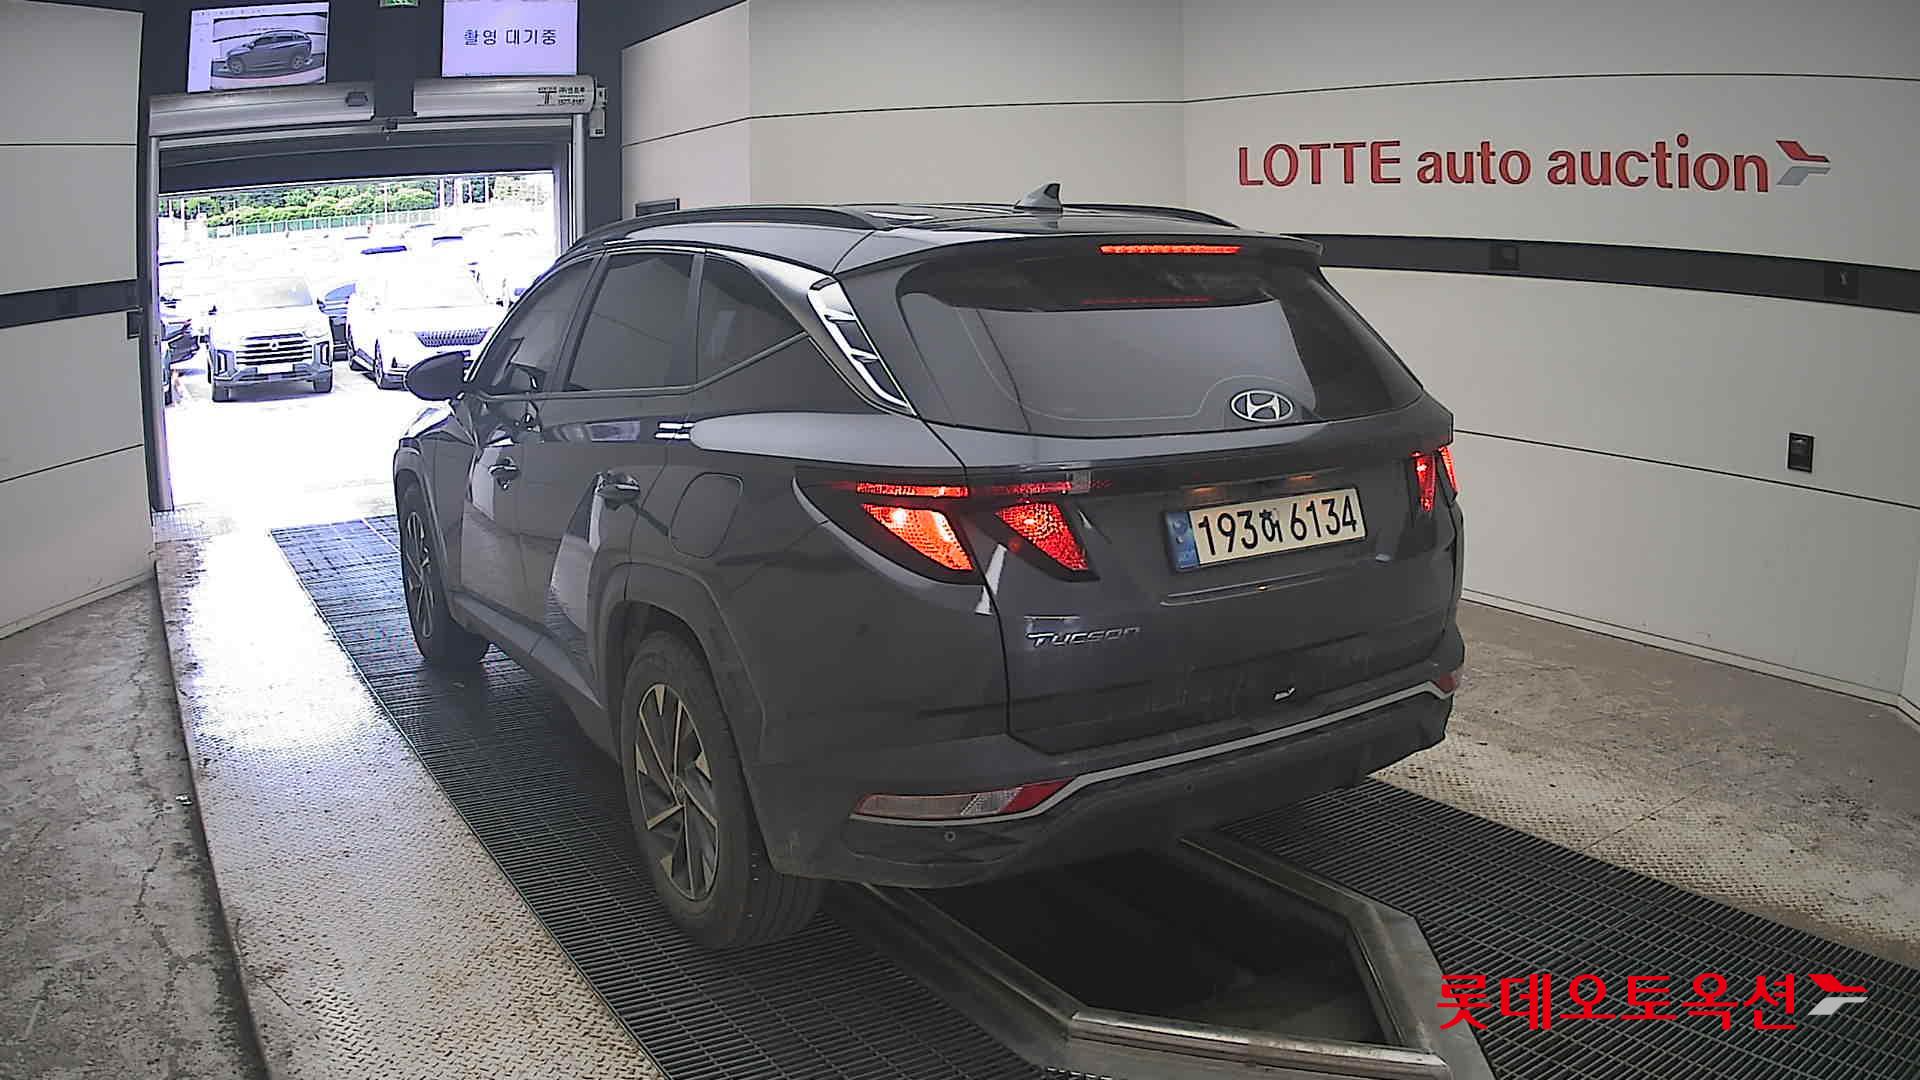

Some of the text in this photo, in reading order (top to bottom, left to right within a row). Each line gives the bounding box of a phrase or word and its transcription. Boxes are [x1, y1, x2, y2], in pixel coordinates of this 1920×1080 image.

[464, 29, 557, 46] 촬영 대기중
[1239, 133, 1769, 192] LOTTE auto auction
